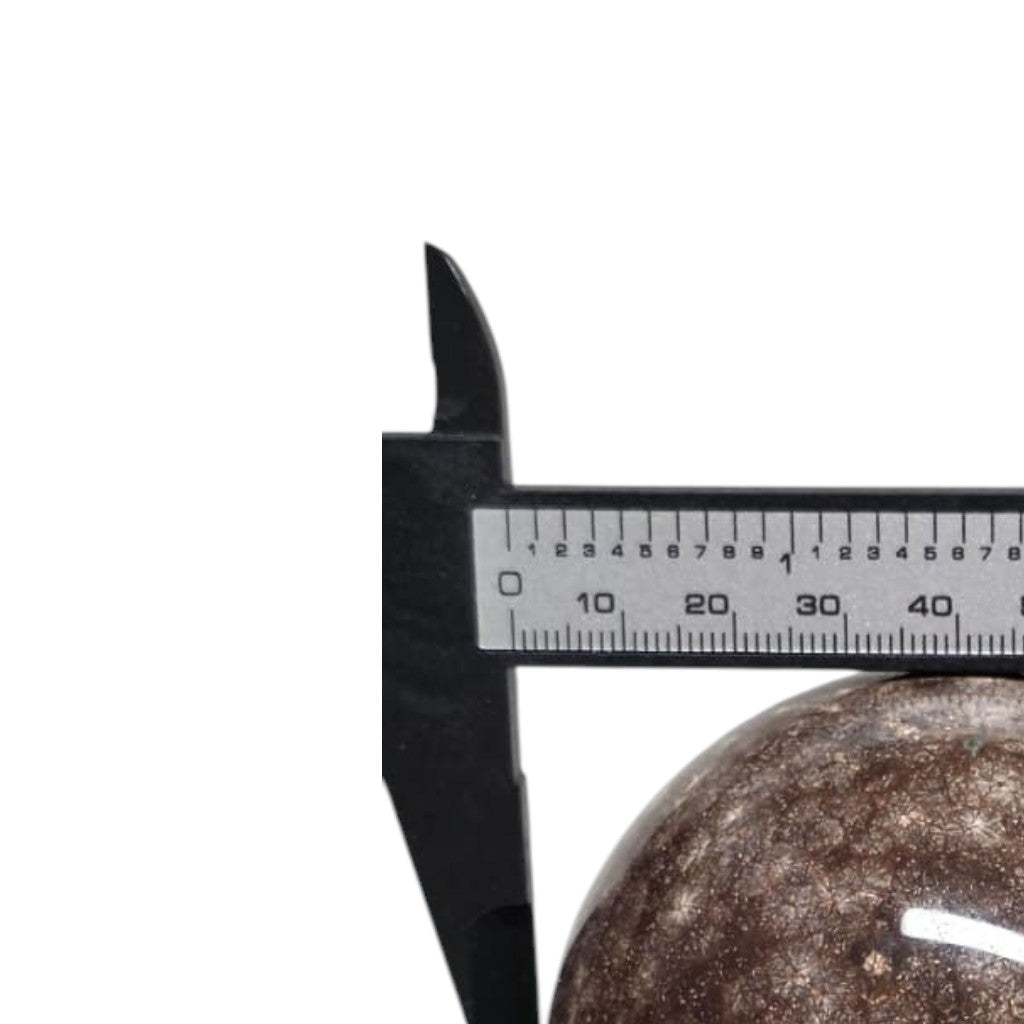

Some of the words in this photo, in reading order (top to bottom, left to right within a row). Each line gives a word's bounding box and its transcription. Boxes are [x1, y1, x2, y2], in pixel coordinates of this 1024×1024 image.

[527, 542, 536, 557] 1
[554, 542, 568, 558] 2
[582, 542, 597, 558] 3
[610, 543, 624, 558] 4
[693, 543, 708, 560] 7
[779, 553, 791, 575] 1
[811, 544, 820, 560] 1
[838, 545, 853, 561] 2
[866, 545, 881, 561] 3
[895, 545, 909, 561] 4
[979, 545, 993, 561] 7
[576, 591, 616, 615] 10
[684, 592, 730, 616] 20
[795, 593, 841, 617] 30
[907, 594, 953, 618] 40
